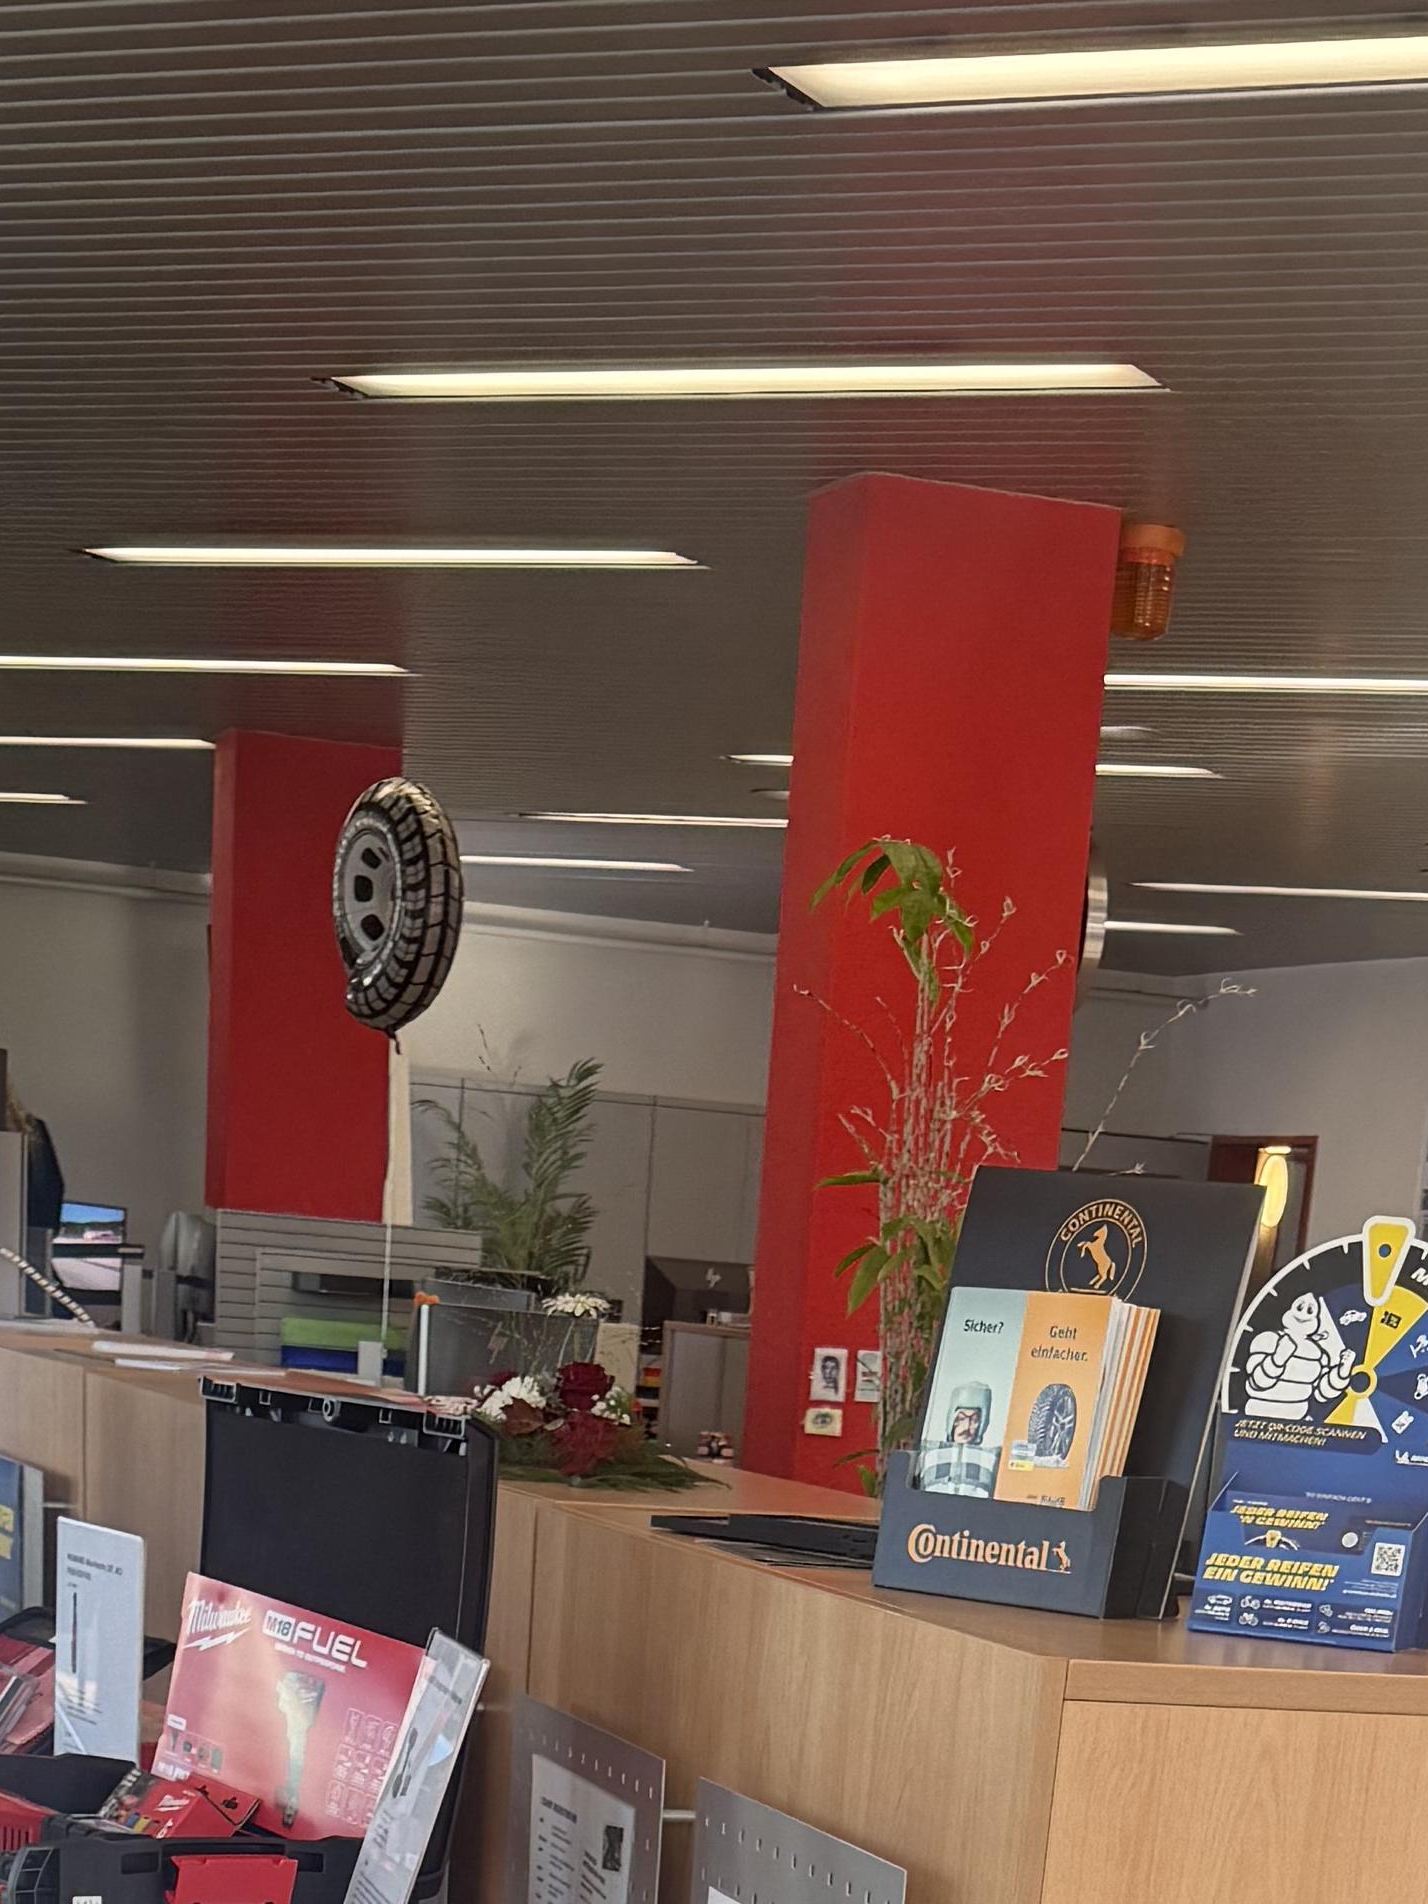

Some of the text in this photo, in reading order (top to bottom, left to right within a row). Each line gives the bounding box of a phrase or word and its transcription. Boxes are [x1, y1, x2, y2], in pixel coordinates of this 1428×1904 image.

[1060, 1202, 1144, 1249] CONTINENTAL
[963, 1318, 1005, 1335] Sicher?
[1049, 1325, 1078, 1340] Geht
[1031, 1345, 1089, 1363] einfacher.
[1314, 1426, 1367, 1440] SCANNEN
[907, 1523, 1048, 1572] Continental
[1202, 1566, 1236, 1582] EIN
[1205, 1552, 1340, 1578] JEDER REIFEN
[186, 1598, 252, 1636] Milwaukee
[293, 1621, 369, 1669] FUEL
